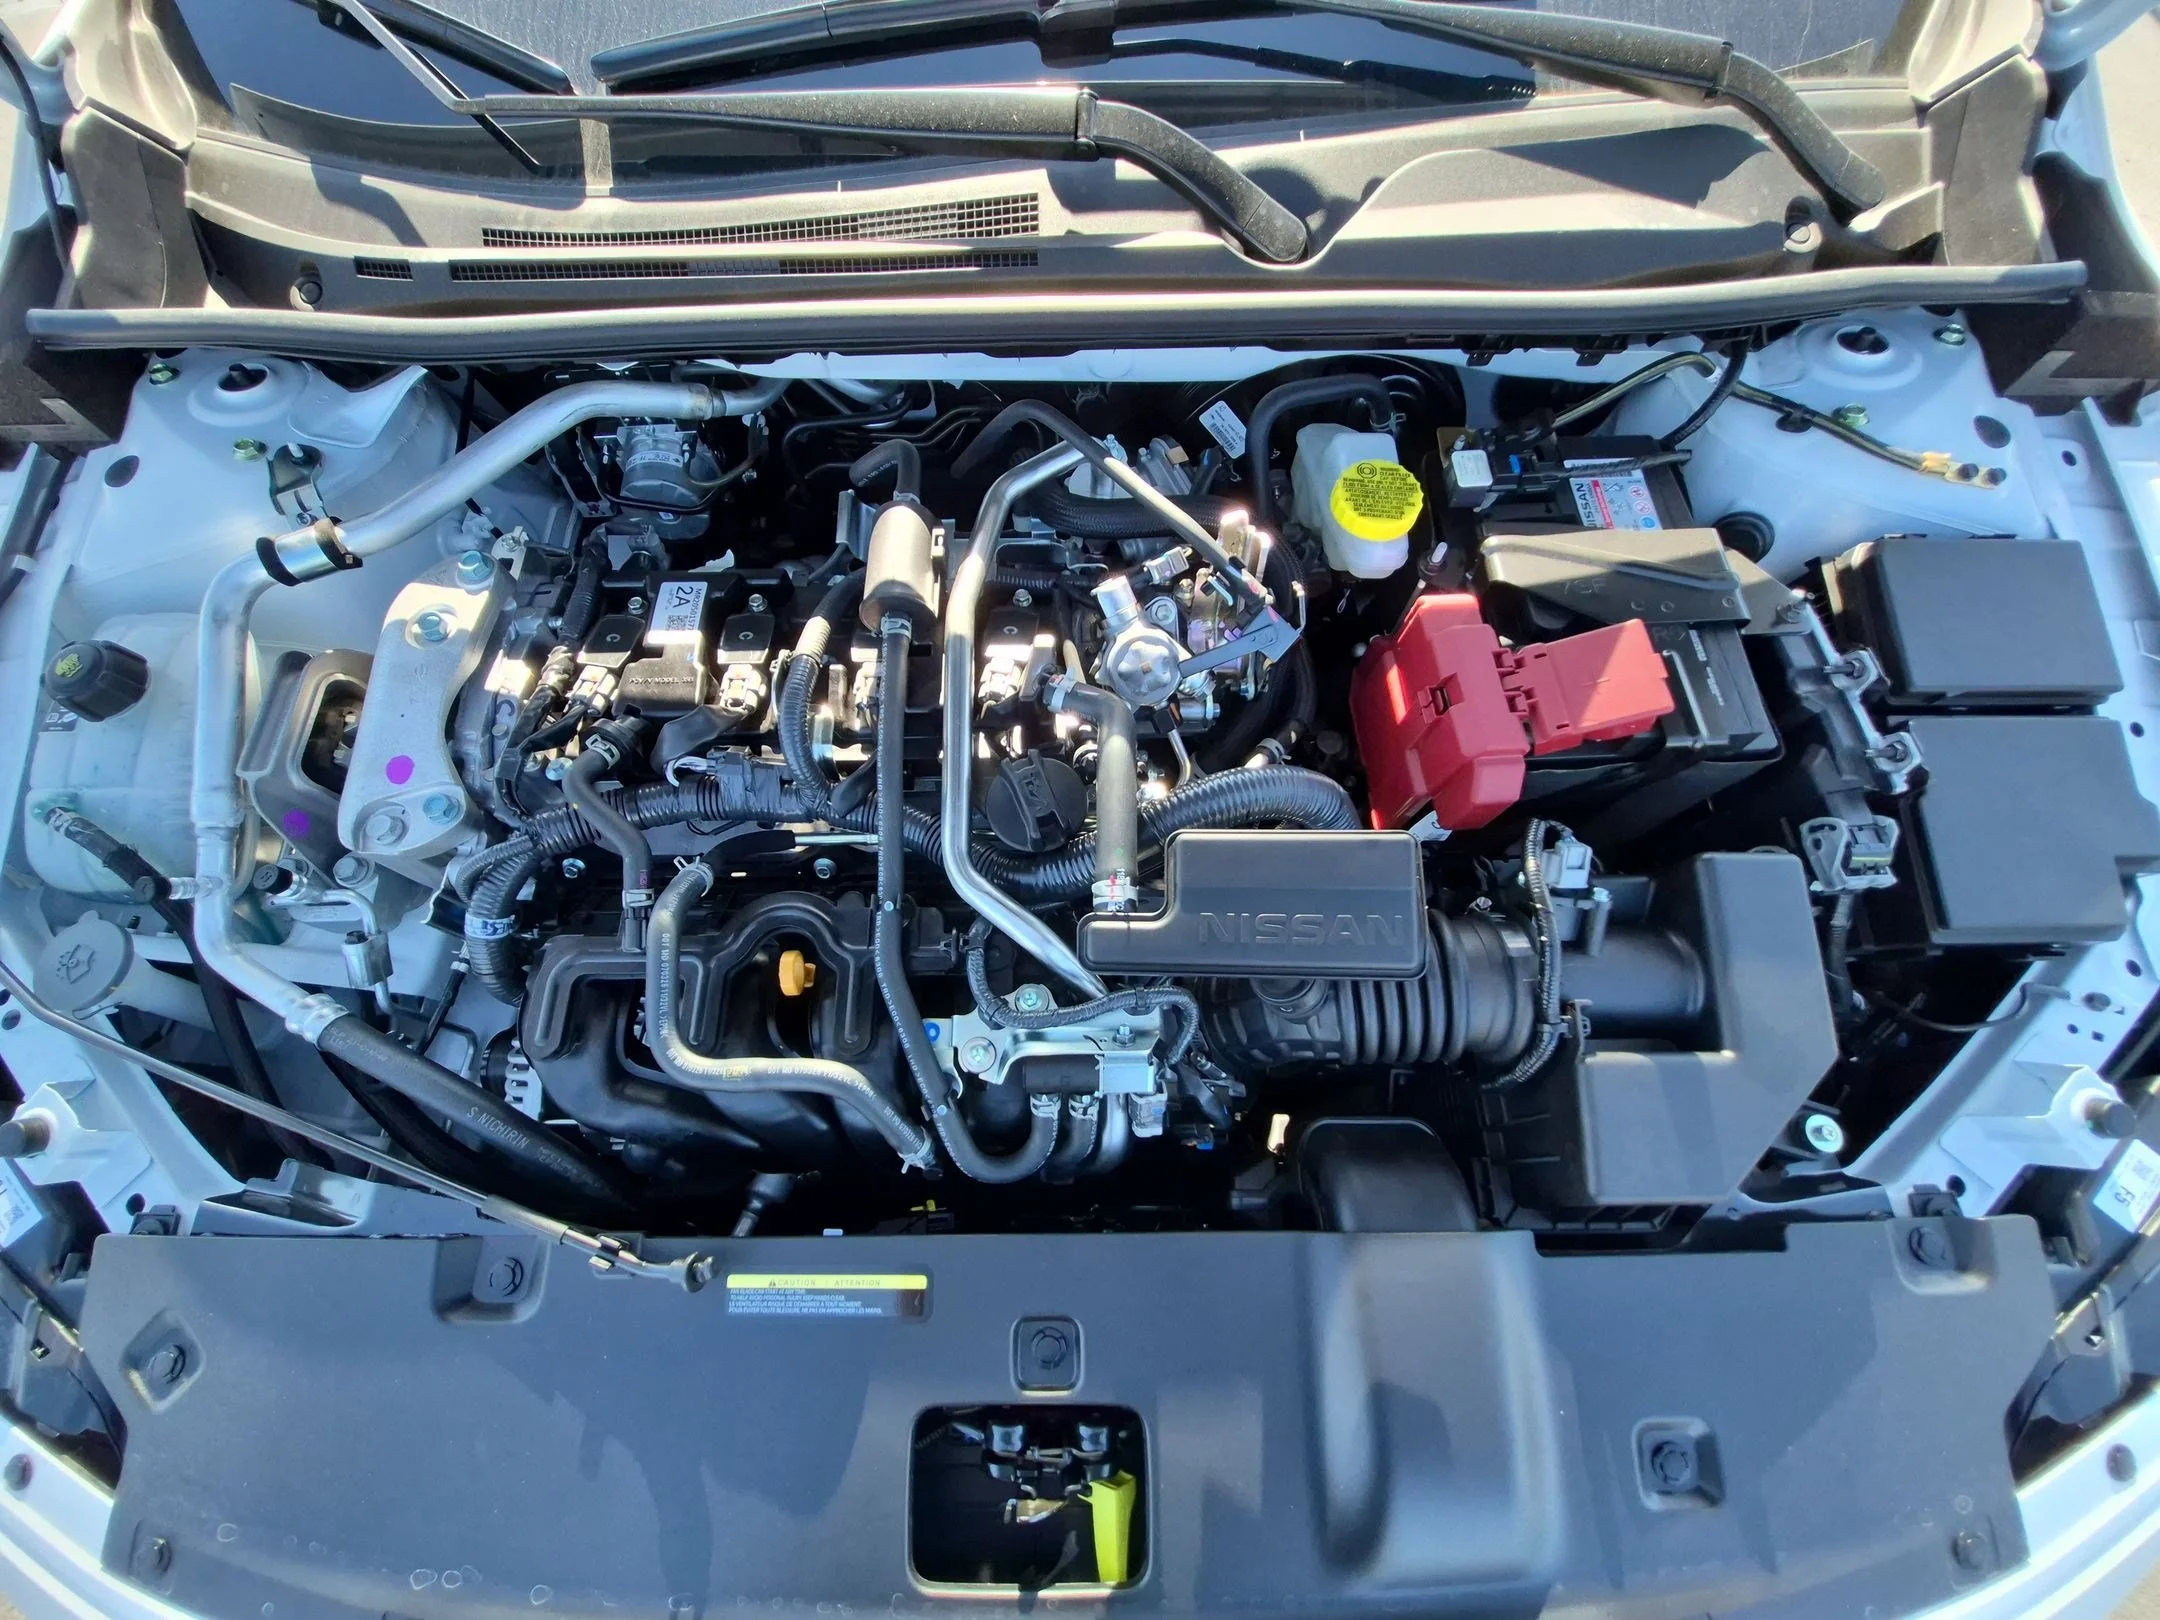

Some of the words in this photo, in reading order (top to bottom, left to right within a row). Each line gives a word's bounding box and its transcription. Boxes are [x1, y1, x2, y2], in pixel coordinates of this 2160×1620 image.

[673, 586, 693, 608] 2A
[1198, 912, 1404, 946] NISSAN
[478, 1111, 530, 1149] NICHIRIN
[834, 1279, 881, 1287] ATTENTION
